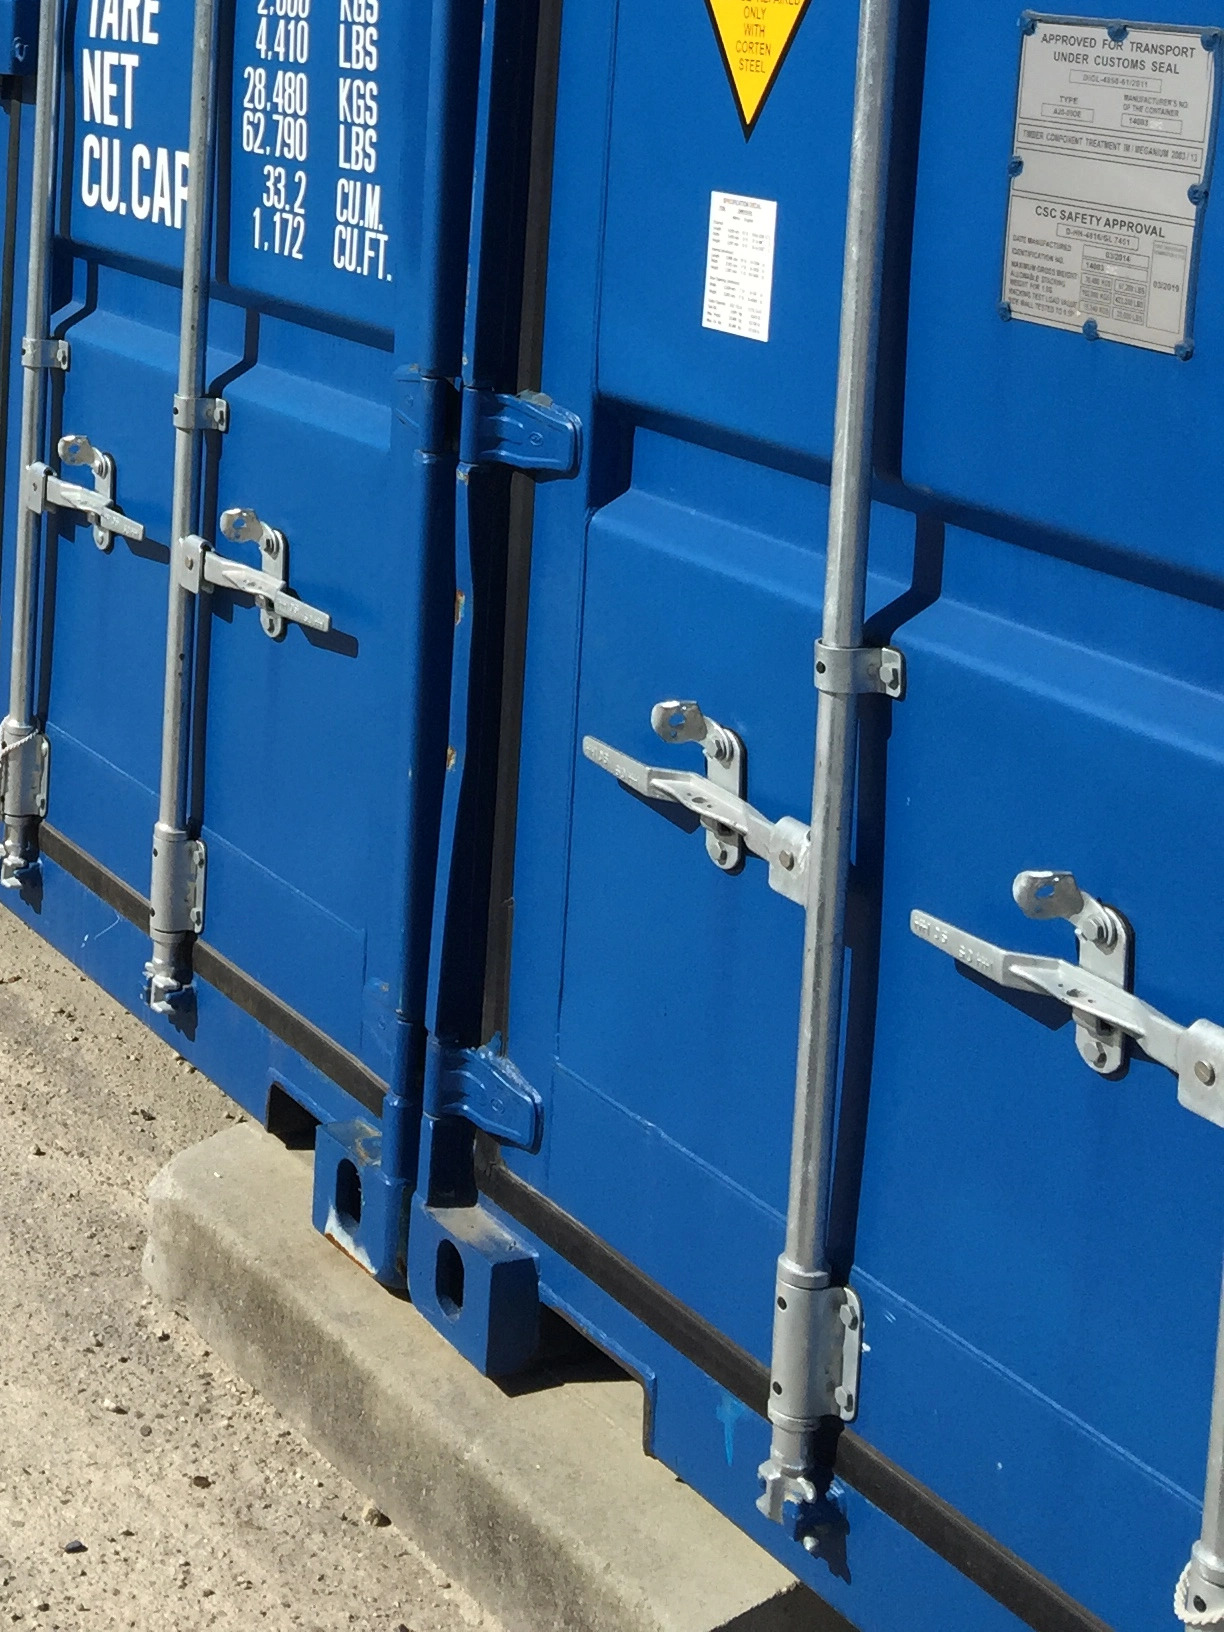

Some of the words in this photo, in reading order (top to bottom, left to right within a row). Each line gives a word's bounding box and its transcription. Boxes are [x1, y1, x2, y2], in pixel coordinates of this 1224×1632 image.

[743, 5, 767, 20] ONLY
[744, 23, 765, 38] WITH
[339, 24, 378, 71] LBS
[735, 40, 771, 57] CORTEN
[1041, 33, 1097, 49] APPROVED
[1102, 39, 1124, 51] FOR
[1129, 41, 1196, 59] TRANSPORT
[739, 58, 766, 74] STEEL
[1053, 51, 1089, 65] UNDER
[1094, 55, 1146, 71] CUSTOMS
[1151, 61, 1180, 74] SEAL
[83, 49, 139, 130] NET
[339, 77, 378, 125] KGS
[339, 125, 378, 174] LBS
[1046, 132, 1083, 146] COMPONENT
[1086, 137, 1122, 151] TREATMENT
[262, 166, 306, 215] 33.2
[336, 178, 383, 231] CU.M.
[1035, 205, 1057, 219] CSC
[1060, 210, 1102, 227] SAFETY
[1104, 216, 1165, 238] APPROVAL
[333, 225, 392, 283] CU.FT.
